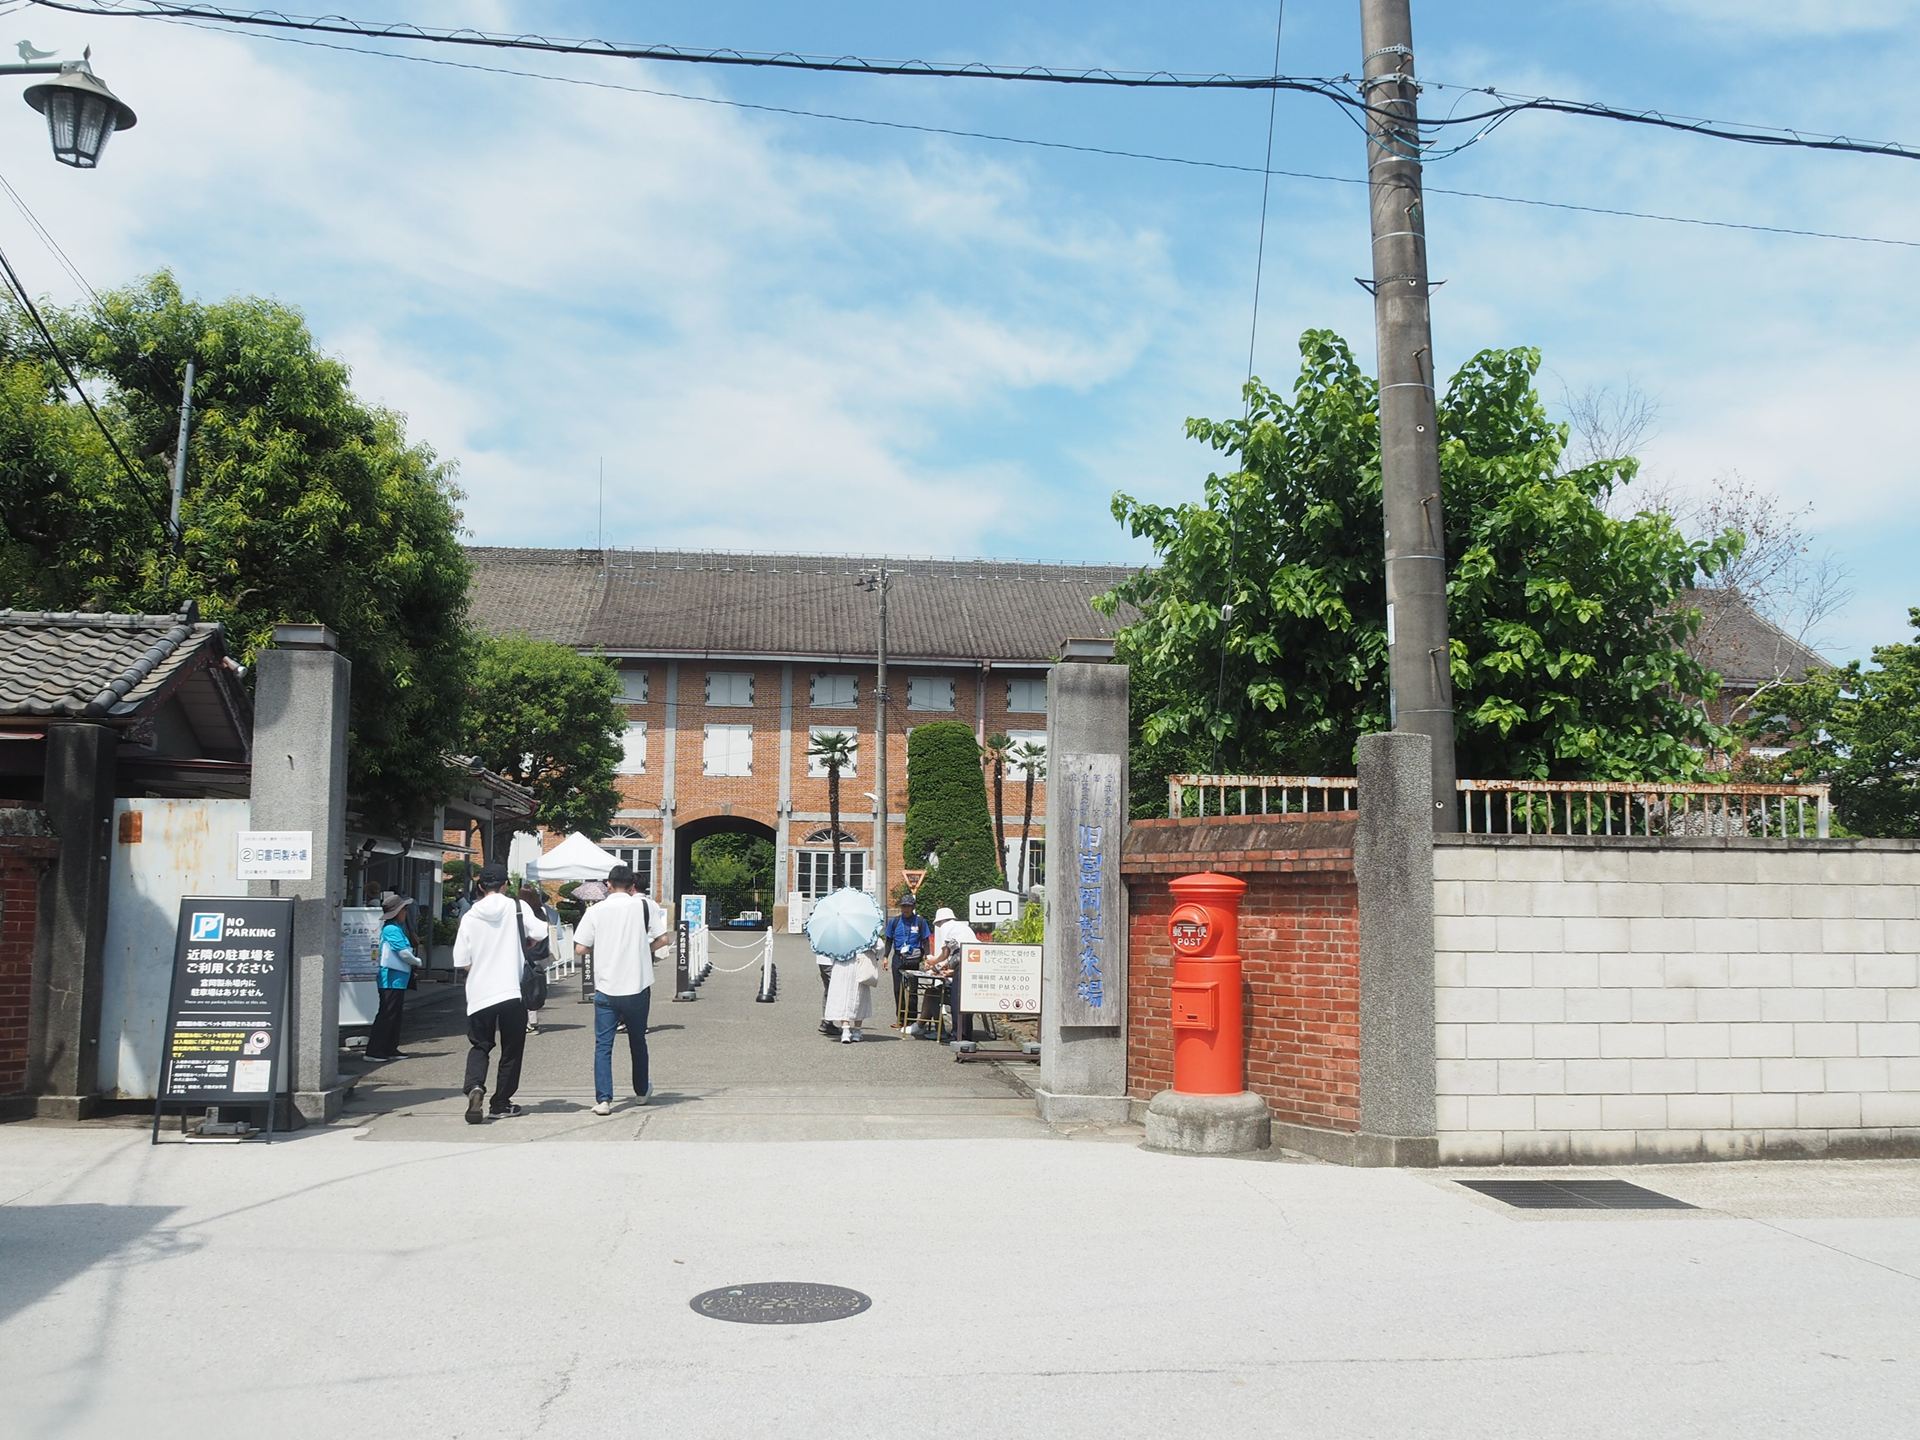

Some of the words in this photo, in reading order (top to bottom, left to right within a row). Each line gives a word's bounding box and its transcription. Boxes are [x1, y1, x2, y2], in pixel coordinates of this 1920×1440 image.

[975, 900, 1012, 916] 出口
[226, 918, 245, 926] NO
[225, 928, 276, 937] PARKING
[1177, 938, 1201, 946] POST
[186, 949, 275, 961] 近隣の駐車場を
[186, 962, 274, 974] ご利用ください
